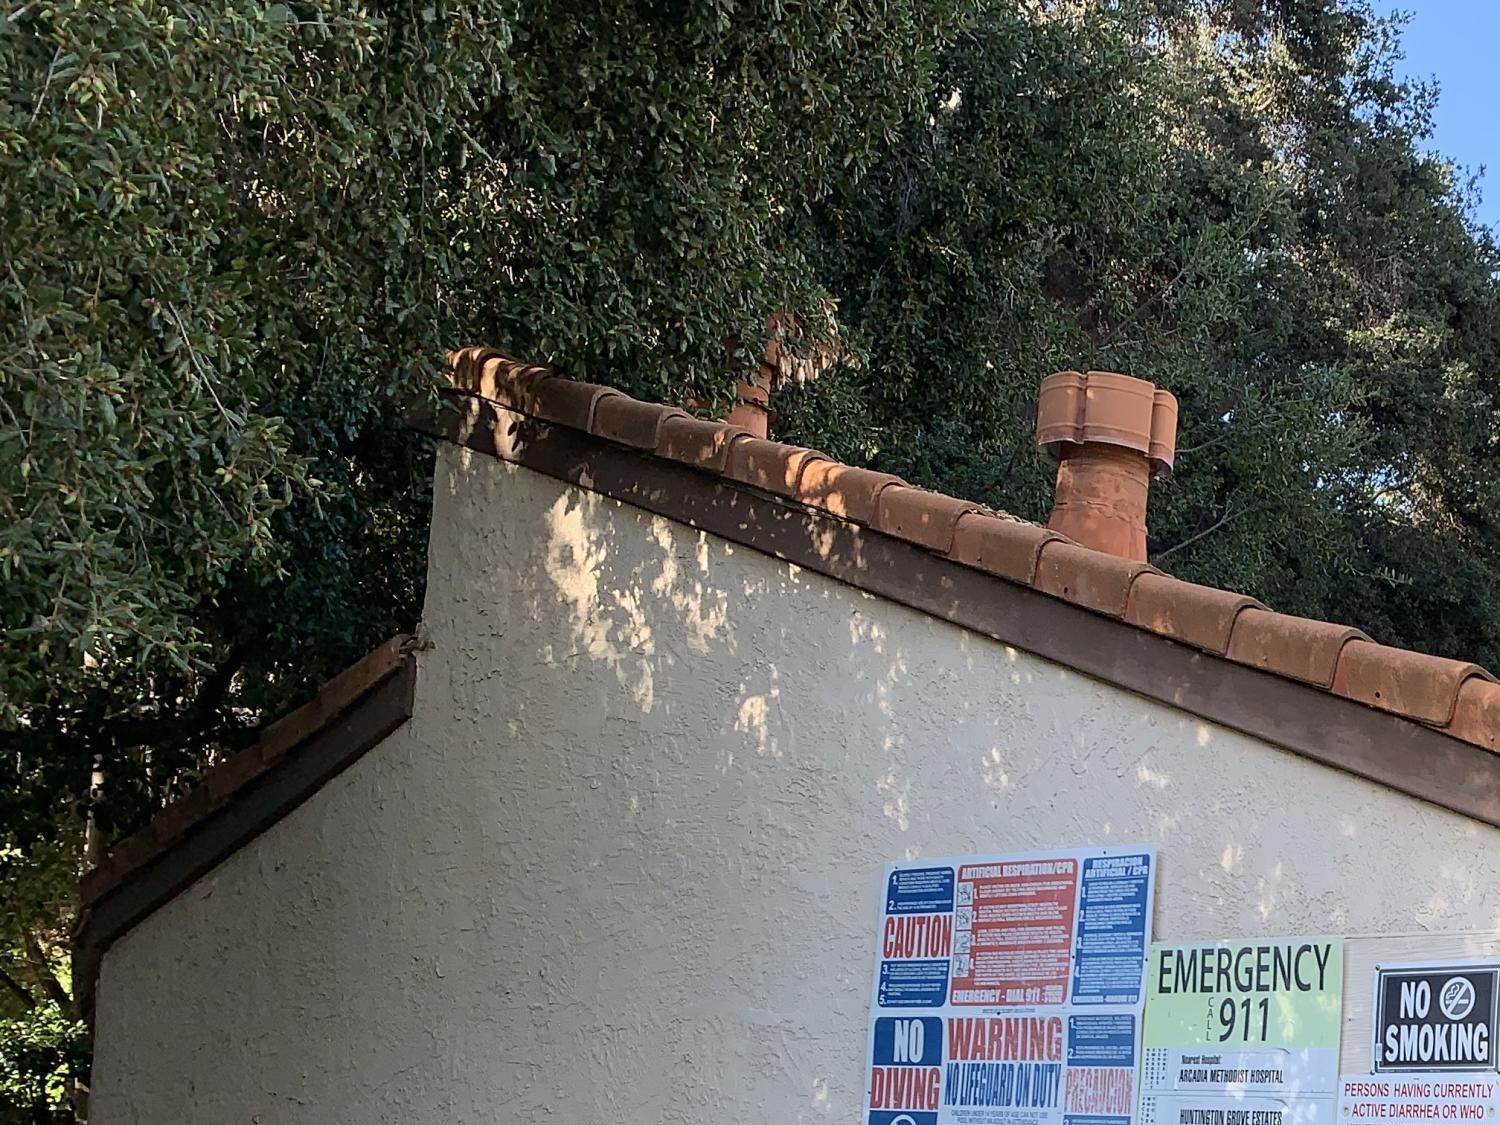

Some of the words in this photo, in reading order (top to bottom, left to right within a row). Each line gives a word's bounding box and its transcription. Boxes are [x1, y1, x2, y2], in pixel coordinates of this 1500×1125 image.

[883, 915, 952, 959] CAUTION
[1158, 944, 1332, 993] EMERGENCY
[952, 988, 1000, 1003] EMERGENCY
[1400, 980, 1431, 1019] NO
[948, 1016, 1062, 1061] WARNING
[1206, 996, 1214, 1041] CALL
[1219, 997, 1269, 1042] 911
[894, 1019, 925, 1063] NO
[1385, 1023, 1488, 1062] SMOKING
[870, 1067, 941, 1110] DIVING
[945, 1063, 960, 1106] NO
[960, 1063, 1015, 1107] LIFEGUARD
[1016, 1064, 1031, 1107] ON
[1032, 1064, 1062, 1108] DUTY
[1065, 1069, 1133, 1114] PRECAUCION
[1179, 1069, 1208, 1083] ARCADIA
[1210, 1069, 1248, 1084] METHODIST
[1250, 1069, 1284, 1084] HOSPITAL
[1344, 1083, 1389, 1097] PERSONS
[1394, 1083, 1431, 1098] HAVING
[1433, 1084, 1494, 1098] CURRENTLY
[1352, 1103, 1386, 1117] ACTIVE
[1389, 1104, 1440, 1118] DIARRHEA
[1442, 1105, 1457, 1118] OR
[1460, 1105, 1484, 1119] WHO
